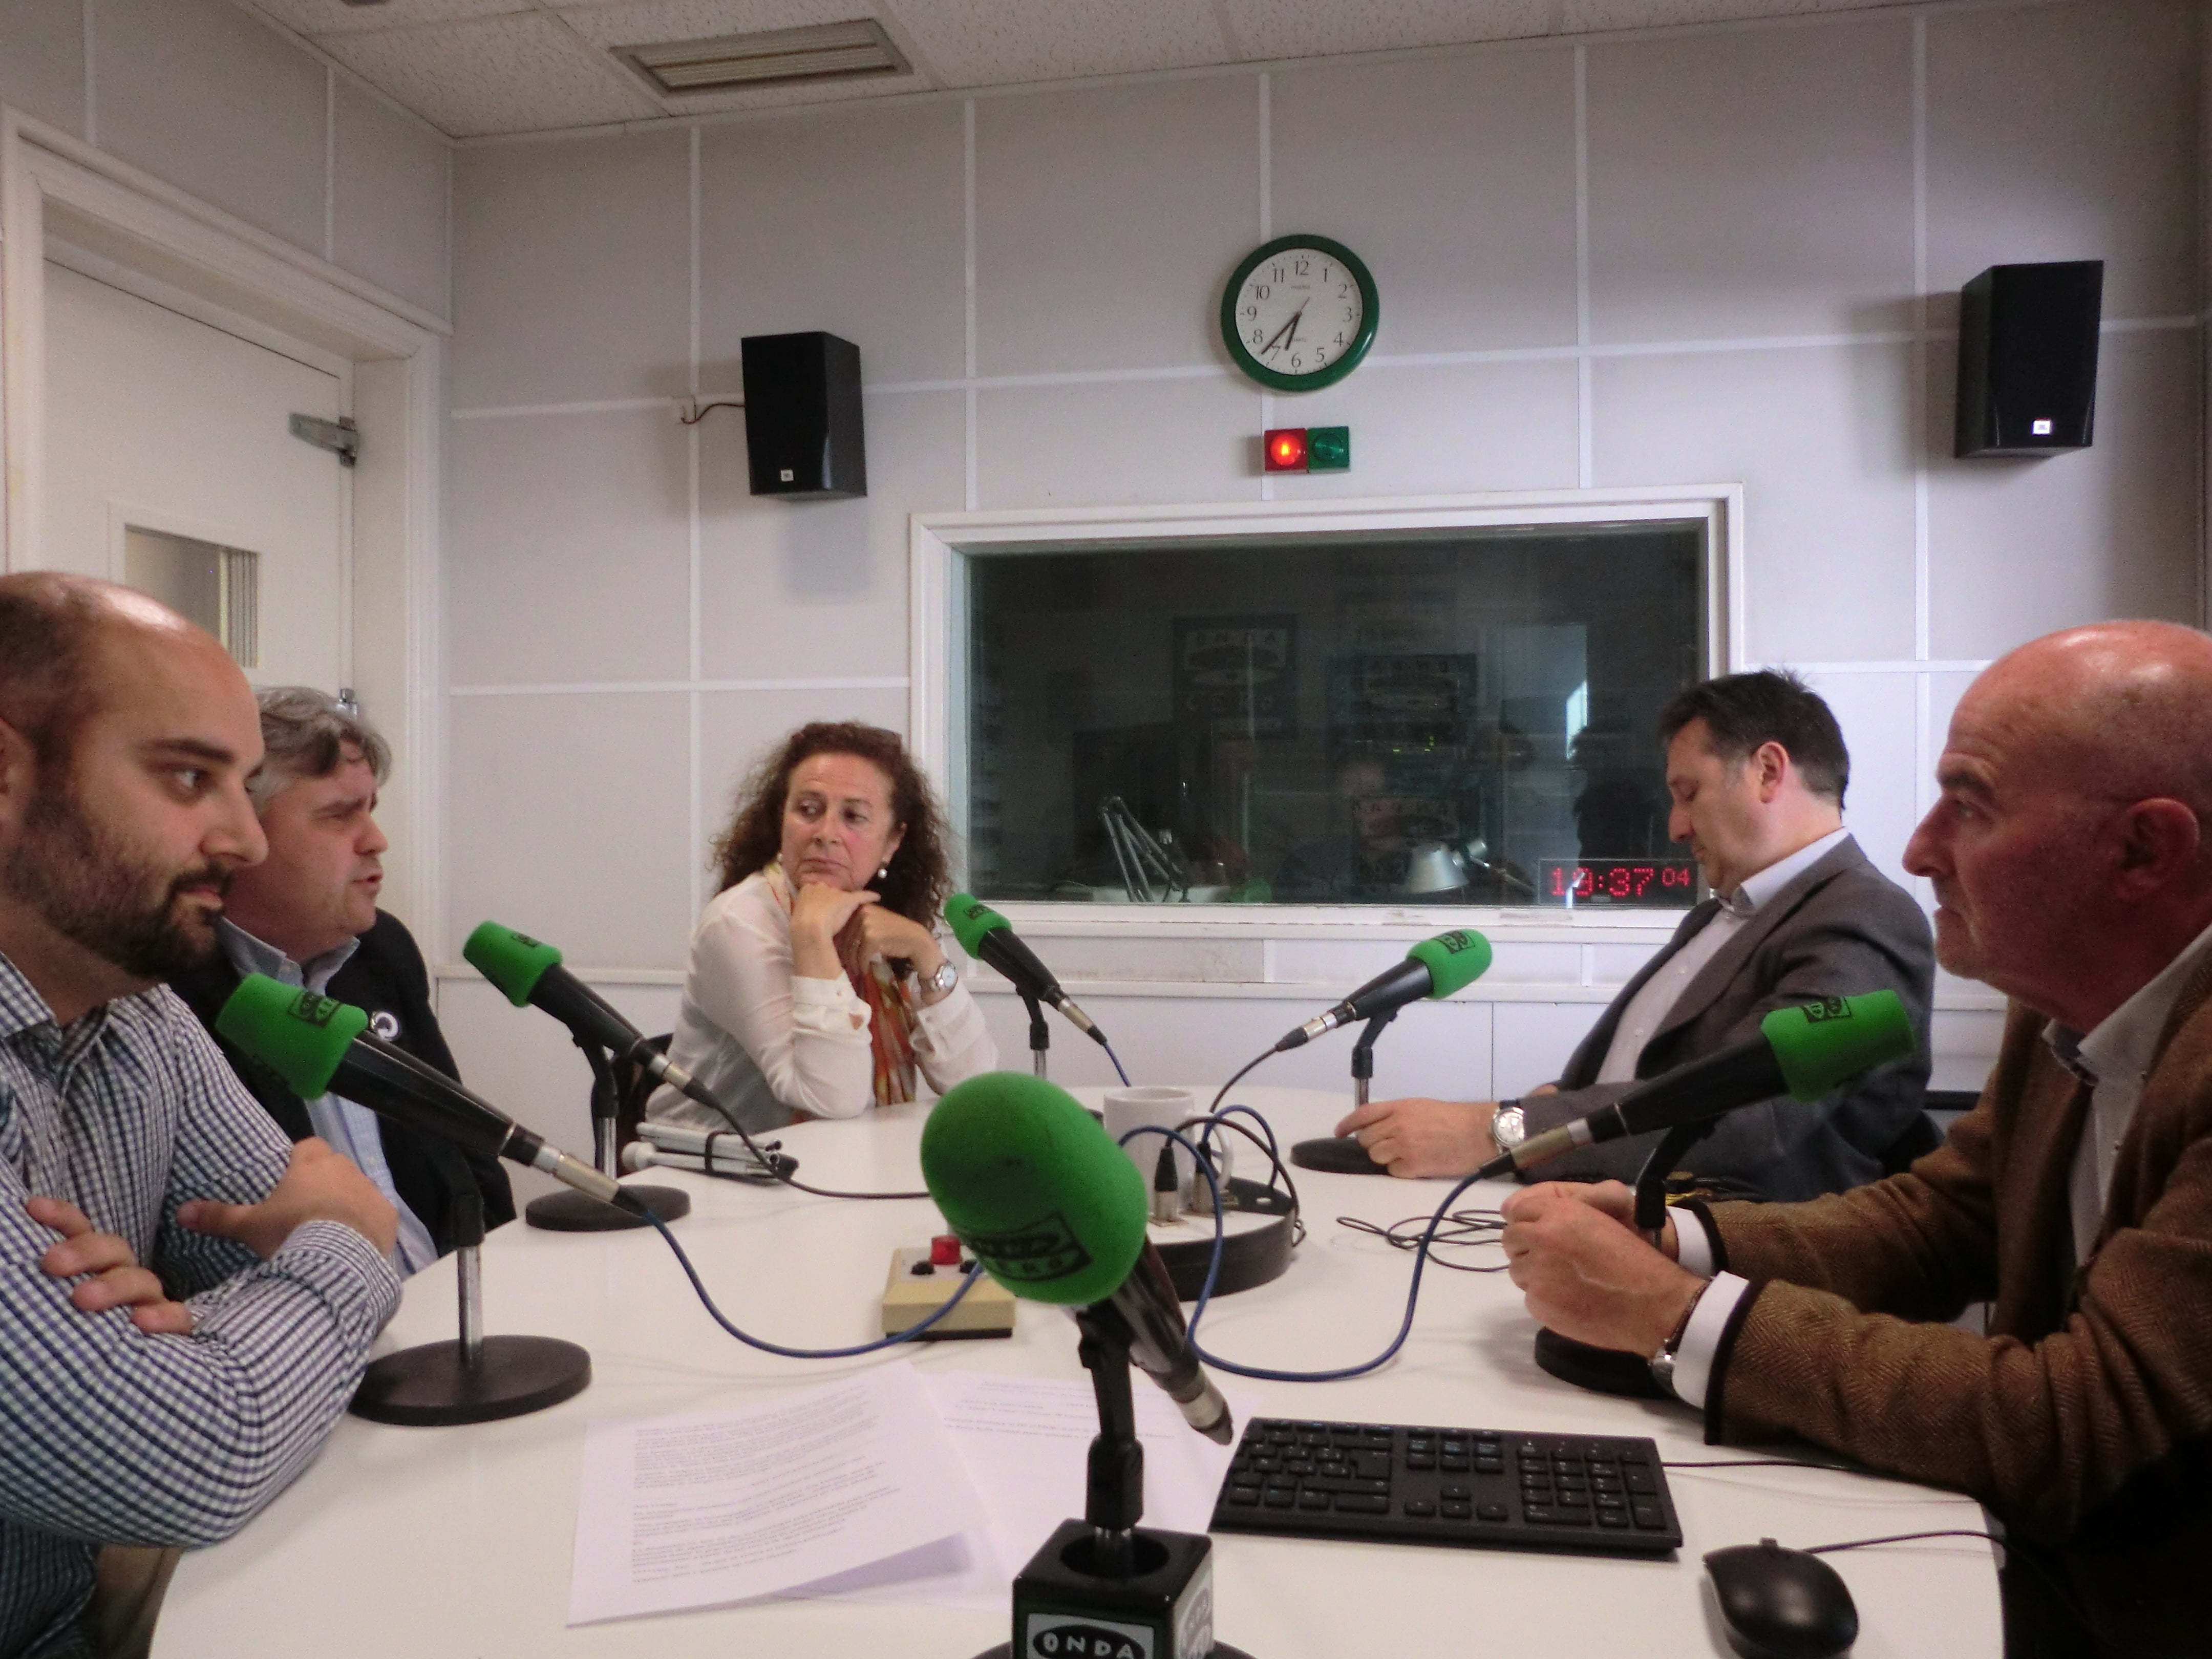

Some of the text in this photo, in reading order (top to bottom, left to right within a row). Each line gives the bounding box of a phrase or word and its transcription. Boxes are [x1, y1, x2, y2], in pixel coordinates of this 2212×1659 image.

[1273, 267, 1284, 283] 11
[1295, 260, 1309, 276] 12
[1324, 267, 1328, 283] 1
[1256, 285, 1270, 300] 10
[1337, 283, 1348, 299] 2
[1247, 306, 1257, 322] 9
[1342, 306, 1352, 323] 3
[1252, 329, 1263, 344] 8
[1333, 331, 1344, 347] 4
[1270, 345, 1281, 361] 7
[1291, 352, 1301, 368] 6
[1315, 347, 1325, 363] 5
[1662, 867, 1689, 886] 04
[1043, 1632, 1135, 1659] ONDA
